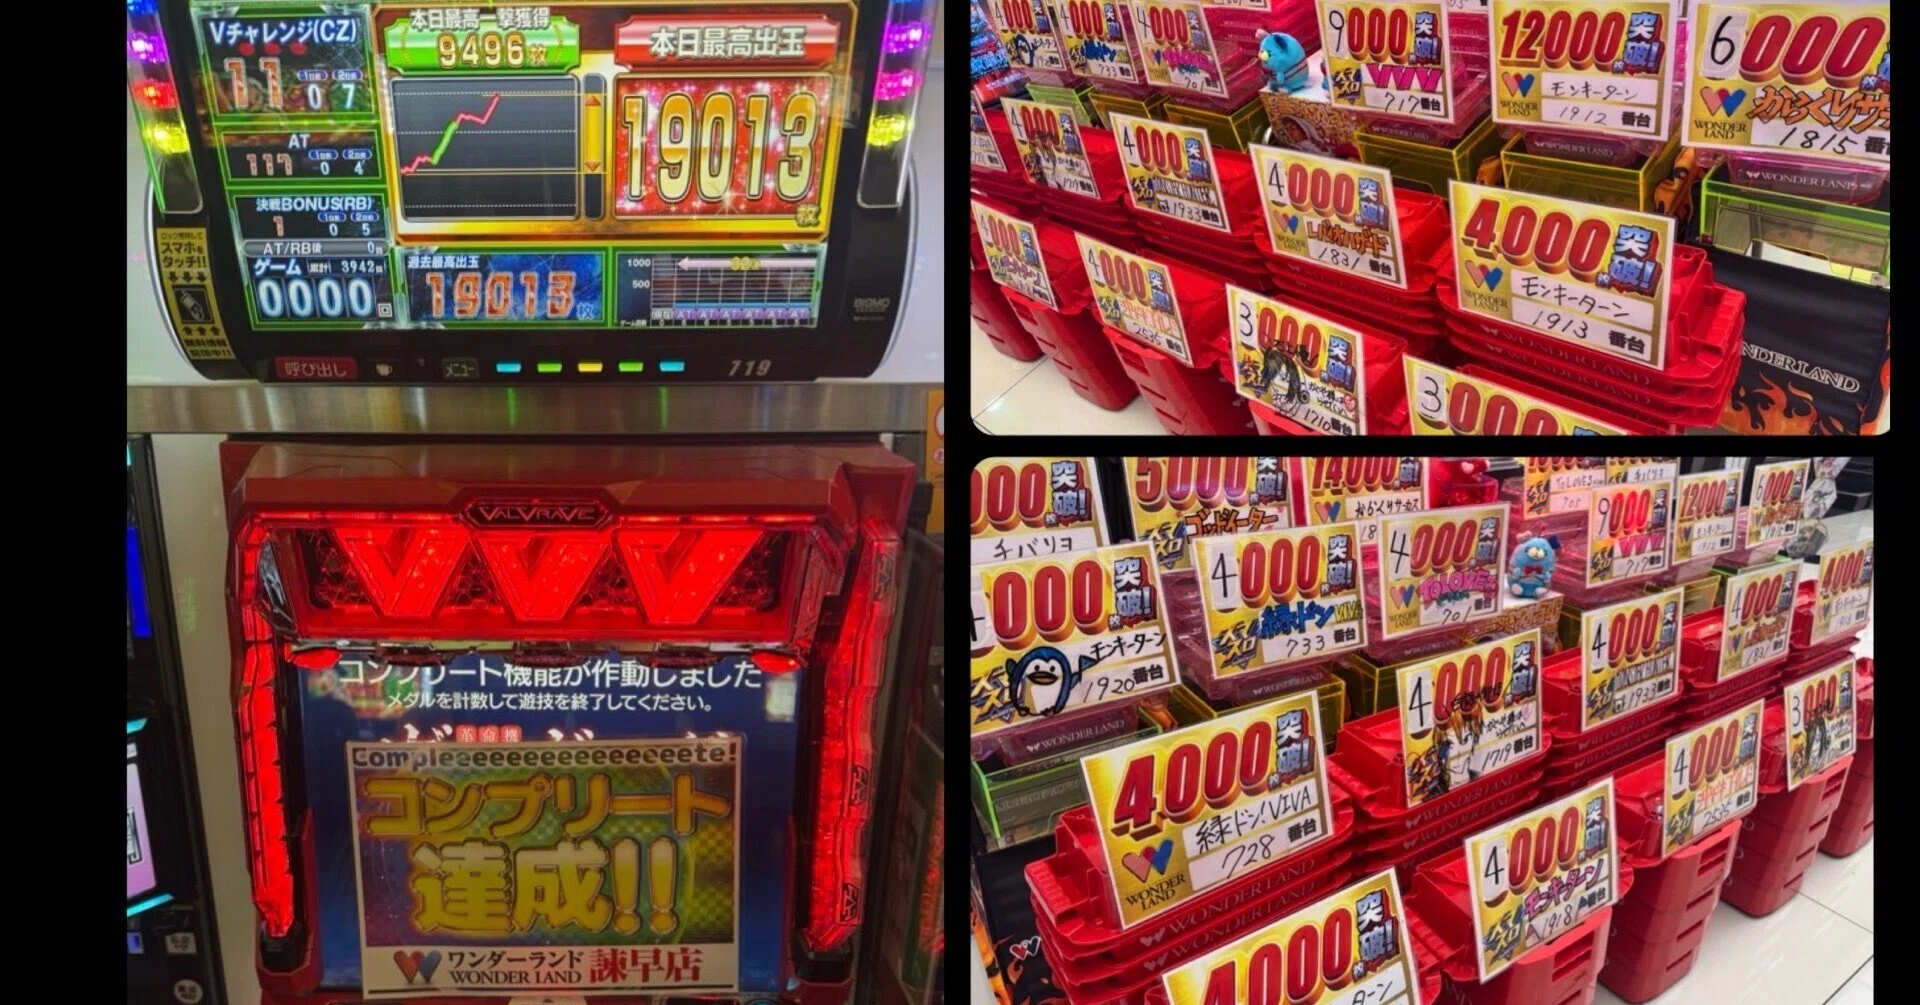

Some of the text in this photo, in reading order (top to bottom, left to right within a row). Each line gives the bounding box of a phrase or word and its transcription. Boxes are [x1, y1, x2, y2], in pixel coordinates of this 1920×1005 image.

[209, 18, 357, 45] Vチャレンジ(CZ)
[411, 8, 550, 30] 本日最高一撃獲得
[1137, 6, 1189, 44] 4000
[1329, 7, 1409, 56] 9000
[1501, 10, 1626, 63] 12000
[649, 27, 806, 59] 本日最高出玉
[1710, 15, 1886, 79] 6000
[224, 57, 283, 110] 11
[308, 83, 356, 109] 0 7
[1366, 63, 1444, 93] VVV
[1551, 81, 1638, 101] モンキーターン
[1501, 101, 1538, 111] WONDER
[1508, 108, 1530, 117] LAND
[1559, 106, 1651, 128] 1912 番台
[288, 134, 310, 149] AT
[1694, 120, 1747, 132] WONDER
[1704, 130, 1735, 140] LAND
[1779, 127, 1858, 155] 1815
[622, 92, 818, 203] 19013
[1124, 125, 1183, 172] 4000
[320, 161, 364, 175] 0 4
[256, 197, 372, 212] 決戦BONUS(RB)
[1269, 162, 1355, 215] 4000
[273, 215, 370, 237] 1 0 5
[1173, 203, 1201, 221] 1933
[1463, 198, 1656, 291] 4000 突破!
[254, 257, 302, 276] ゲーム
[627, 258, 651, 268] 1000
[1089, 248, 1146, 301] 4000
[632, 280, 651, 289] 500
[1465, 289, 1508, 308] WONDER
[1522, 276, 1630, 318] モンキーターン
[1472, 299, 1500, 313] LAND
[1240, 302, 1322, 369] 3000
[1532, 310, 1645, 354] 1913 番台
[284, 361, 348, 378] 呼び出し
[728, 359, 772, 377] 719
[1741, 342, 1860, 393] NDER LAND
[1136, 457, 1250, 501] 5000
[1756, 469, 1794, 503] 6000
[479, 505, 596, 522] VALVRAVE
[1598, 489, 1651, 535] 9000
[1680, 480, 1727, 517] 12000
[1390, 520, 1477, 574] 4000
[1211, 535, 1320, 599] 4000
[1114, 557, 1151, 617] 突破!
[1731, 575, 1783, 624] 4000
[1286, 627, 1356, 658] 733 番台
[1592, 604, 1660, 662] 4000
[1083, 664, 1164, 702] 1920 番台
[1409, 646, 1506, 727] 4000
[388, 691, 713, 712] メダルを計数して遊技を終了してください。
[1114, 711, 1311, 827] 4000 突破!
[1674, 720, 1739, 787] 4000
[362, 772, 732, 838] コンプリート
[1222, 818, 1317, 879] 728 番台
[1484, 807, 1579, 888] 4000
[410, 837, 679, 936] 達成!!
[1125, 872, 1186, 906] WONDER
[1142, 888, 1176, 911] LAND
[447, 947, 703, 983] ワンダーランド 諫早店
[1203, 891, 1393, 1005] 4000 突破!
[449, 970, 582, 985] WONDER LAND
